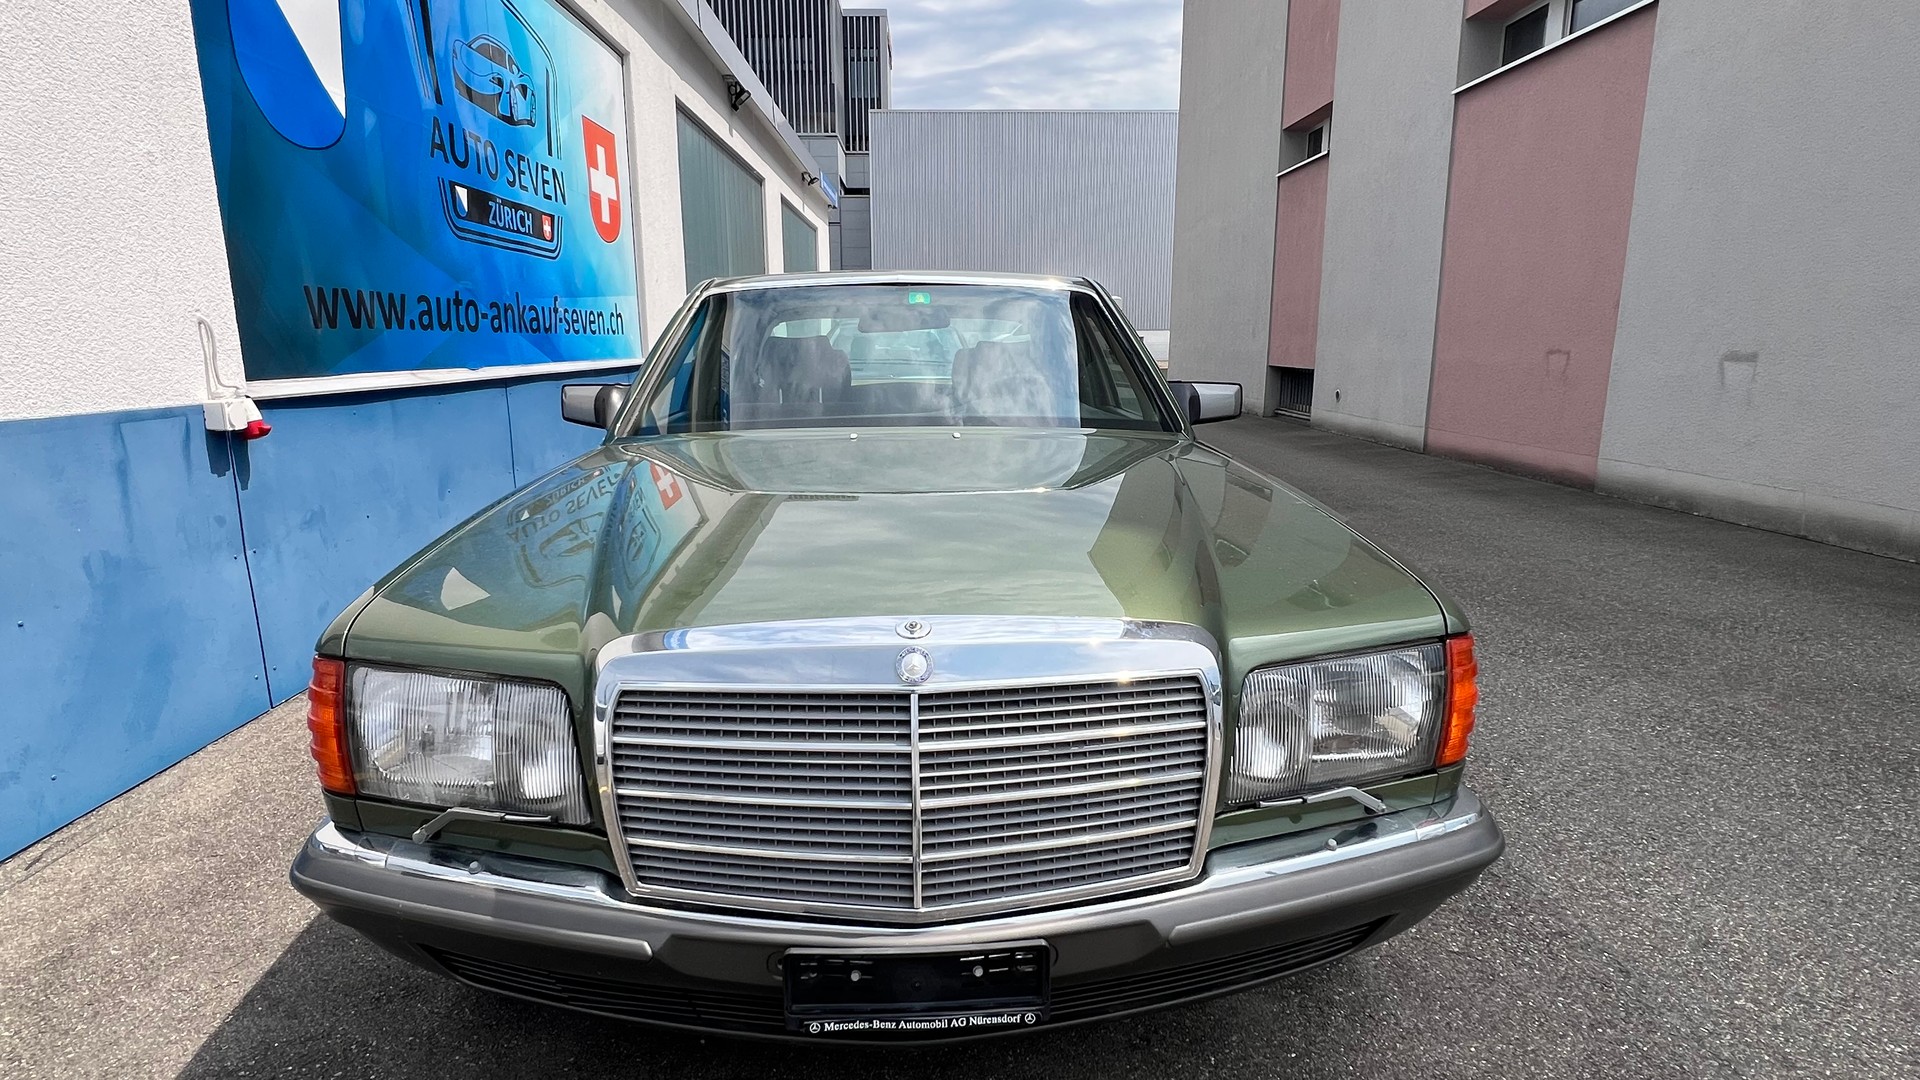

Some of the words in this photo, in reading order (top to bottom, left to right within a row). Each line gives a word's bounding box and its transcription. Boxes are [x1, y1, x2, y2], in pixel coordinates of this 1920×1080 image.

[429, 116, 500, 181] AUTO
[505, 150, 567, 206] SEVEN
[488, 200, 534, 235] ZÜRICH
[304, 285, 625, 336] www.auto-ankauf-seven.ch
[824, 1019, 897, 1032] Mercedes-Benz
[898, 1018, 948, 1030] Automobil
[950, 1017, 967, 1028] AG
[969, 1013, 1022, 1026] Nürensdorf
